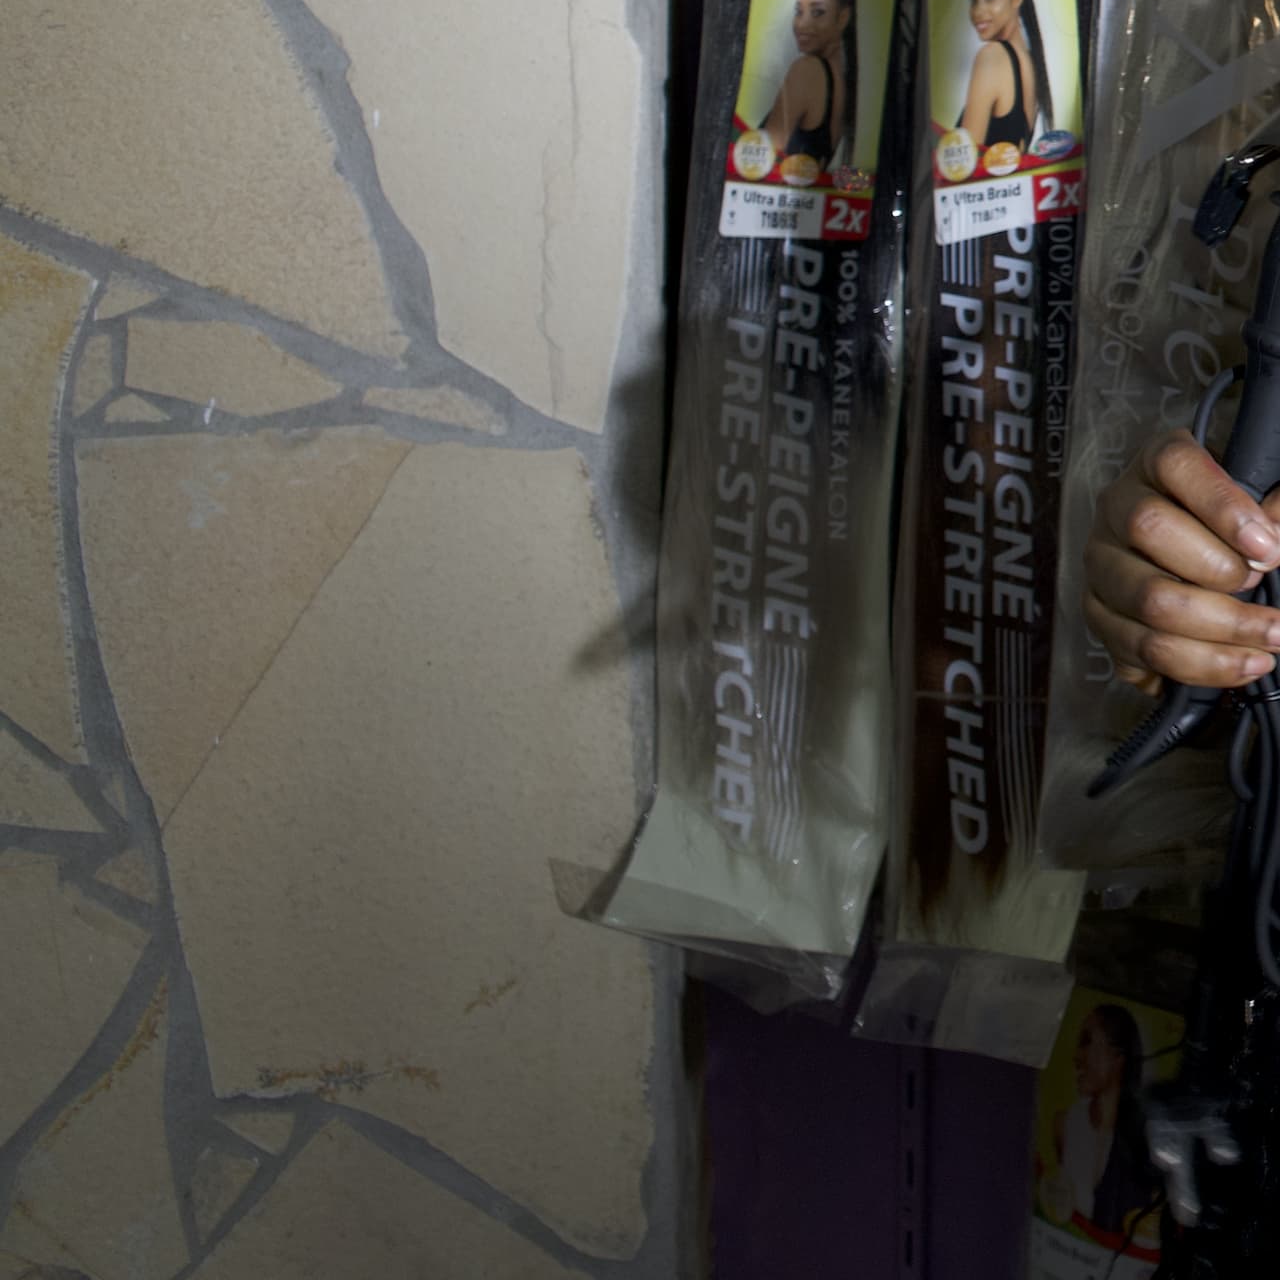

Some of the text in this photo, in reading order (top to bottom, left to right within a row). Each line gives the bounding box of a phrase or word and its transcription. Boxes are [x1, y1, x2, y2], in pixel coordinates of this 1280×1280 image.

[744, 191, 773, 206] Ultra
[826, 199, 867, 233] 2x
[954, 184, 1021, 206] Ultra Braid
[1037, 177, 1080, 211] 2x
[763, 240, 823, 643] PRÉ-PEIGNÉ
[828, 248, 858, 541] 100% KANEKALON
[991, 222, 1039, 620] PRÉ-PEIGNÉ
[1045, 306, 1074, 477] Kanekalon
[939, 291, 990, 855] PRE-STRETCHED
